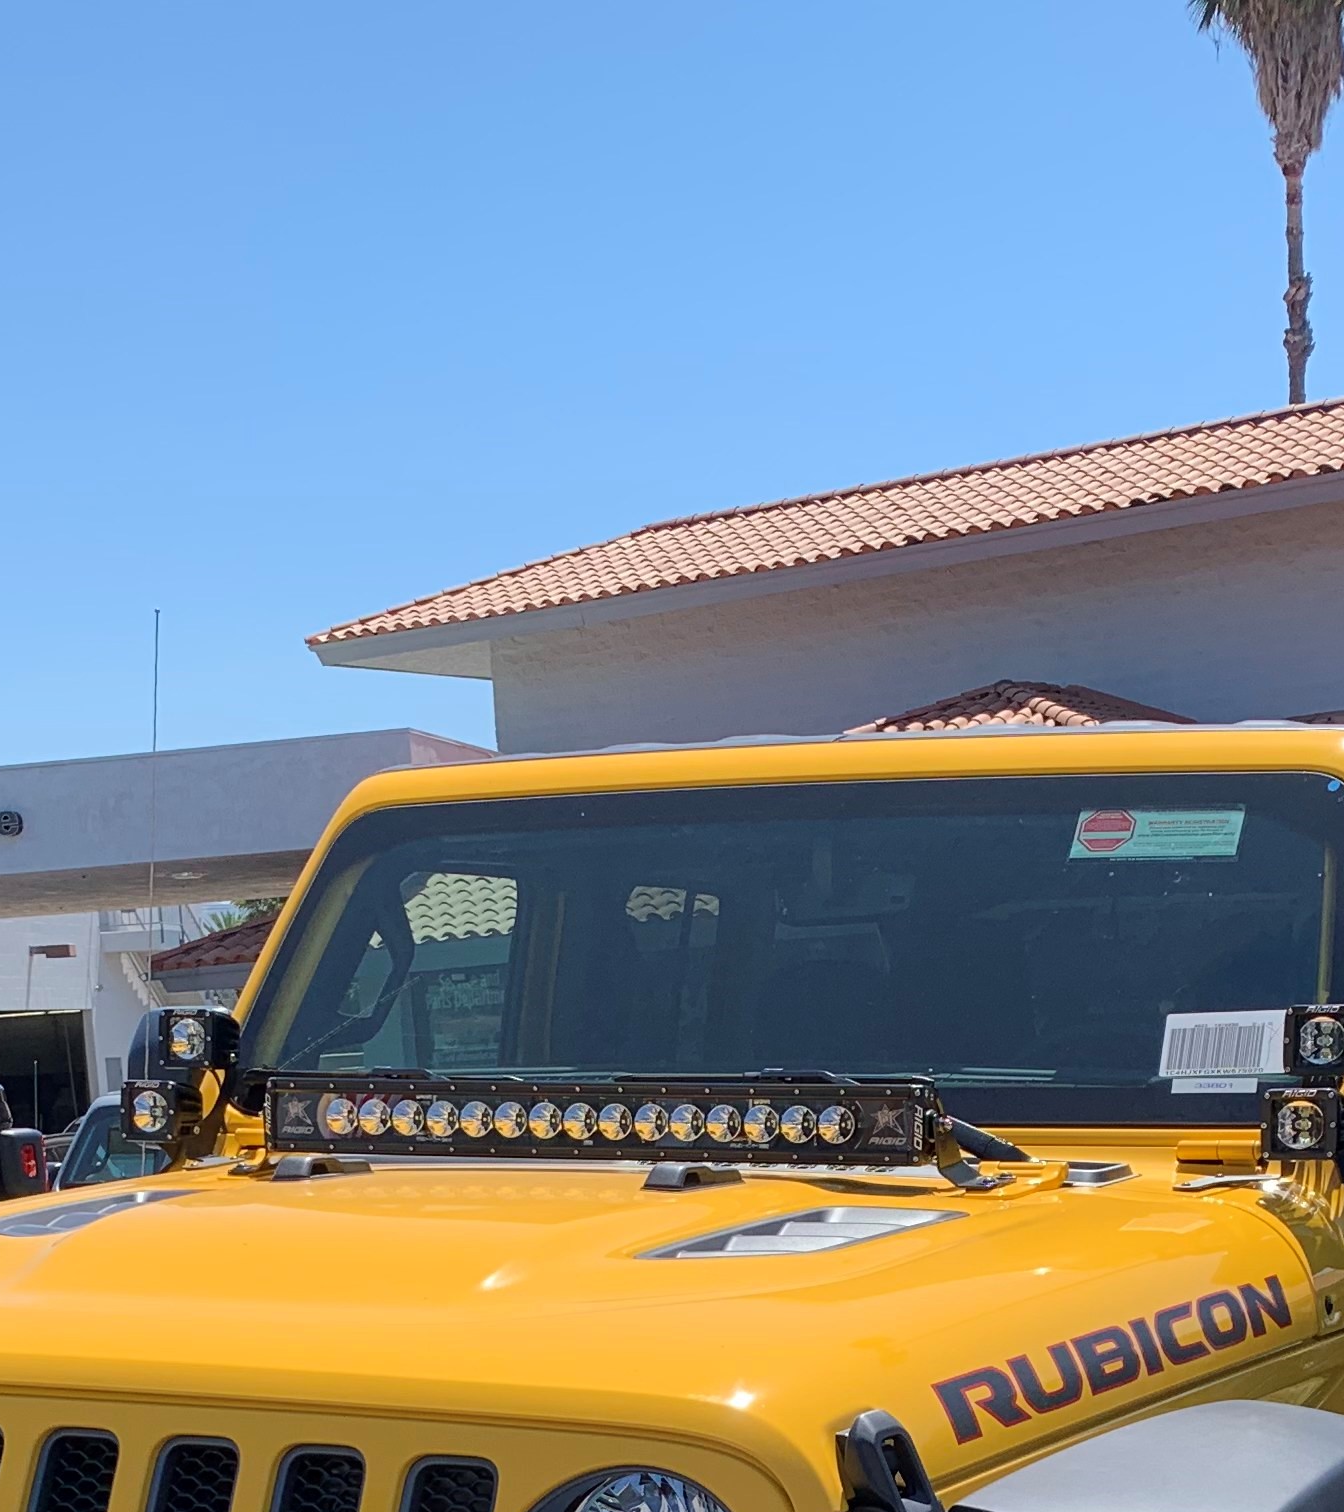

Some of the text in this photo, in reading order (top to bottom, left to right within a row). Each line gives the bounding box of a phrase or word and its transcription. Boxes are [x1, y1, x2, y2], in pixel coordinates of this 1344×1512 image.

[1306, 1005, 1340, 1013] RIGID
[134, 1080, 160, 1089] RIGID
[1282, 1089, 1317, 1098] RIGID
[281, 1125, 315, 1135] RIGID
[913, 1104, 924, 1150] RIGID
[868, 1136, 906, 1146] RIGID
[931, 1274, 1294, 1446] RUBICON
